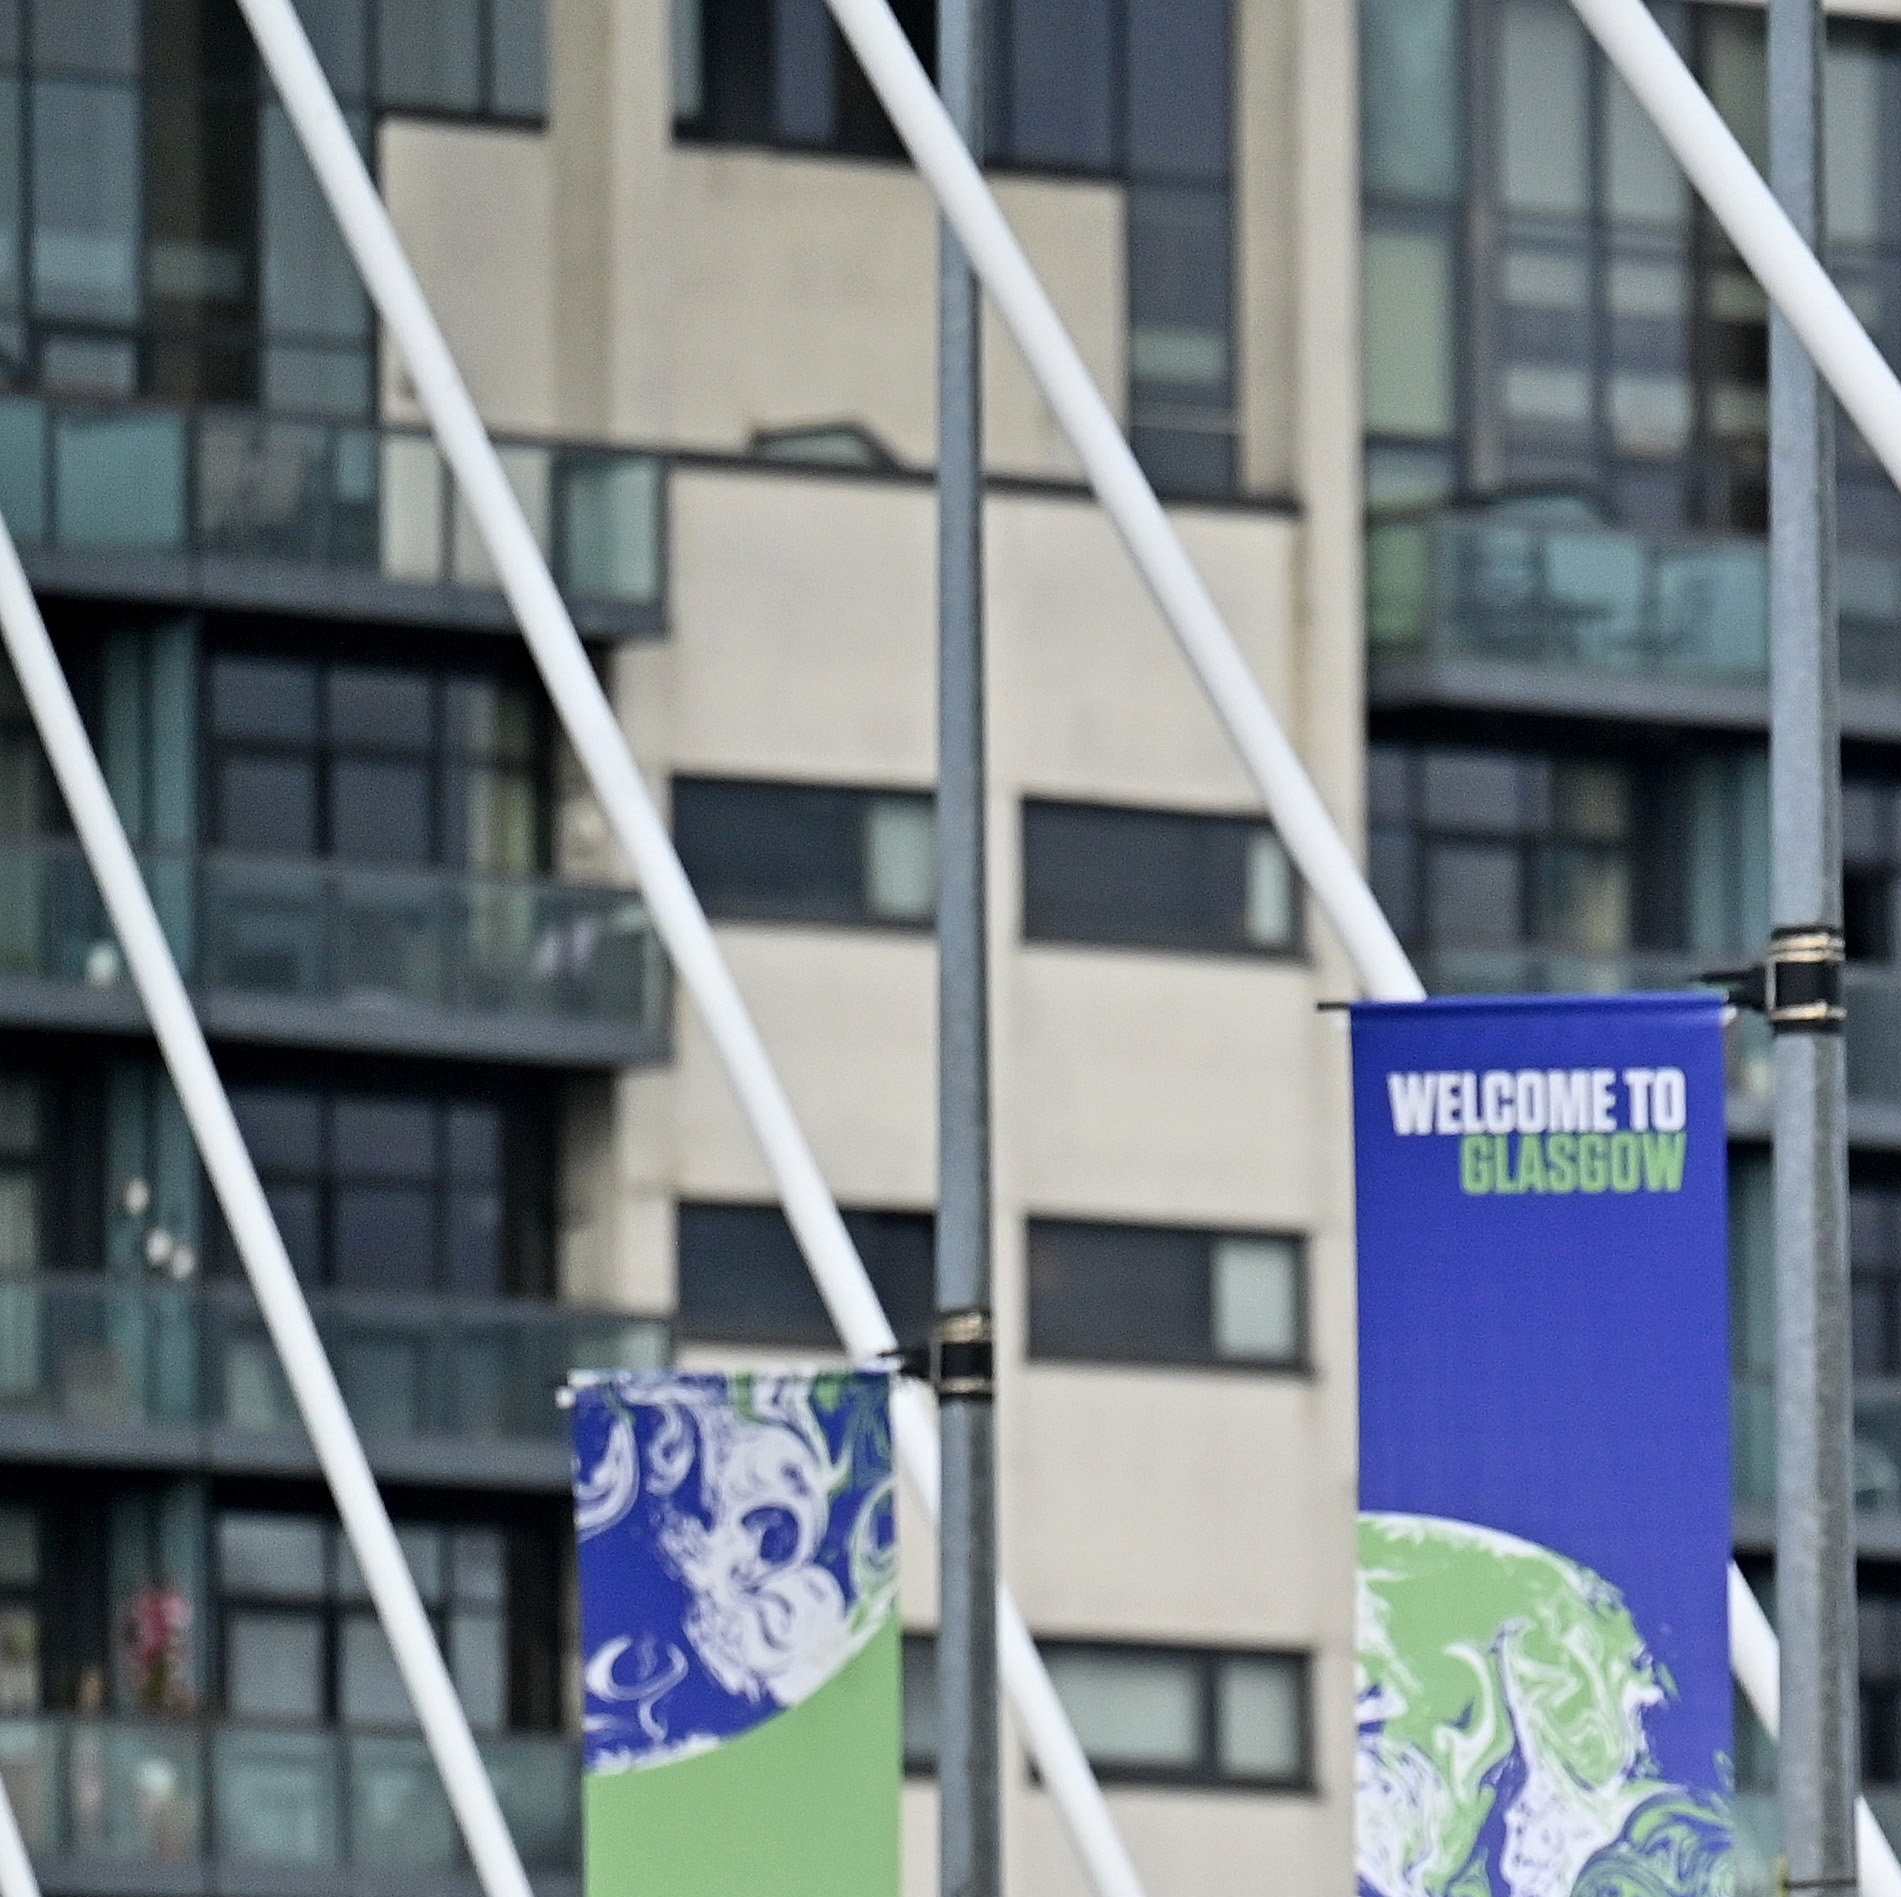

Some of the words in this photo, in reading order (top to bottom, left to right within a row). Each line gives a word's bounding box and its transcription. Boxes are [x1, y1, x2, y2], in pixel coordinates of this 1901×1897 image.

[1387, 1068, 1617, 1135] WELCOME
[1622, 1066, 1687, 1133] TO
[1460, 1131, 1687, 1194] GLASGOW
